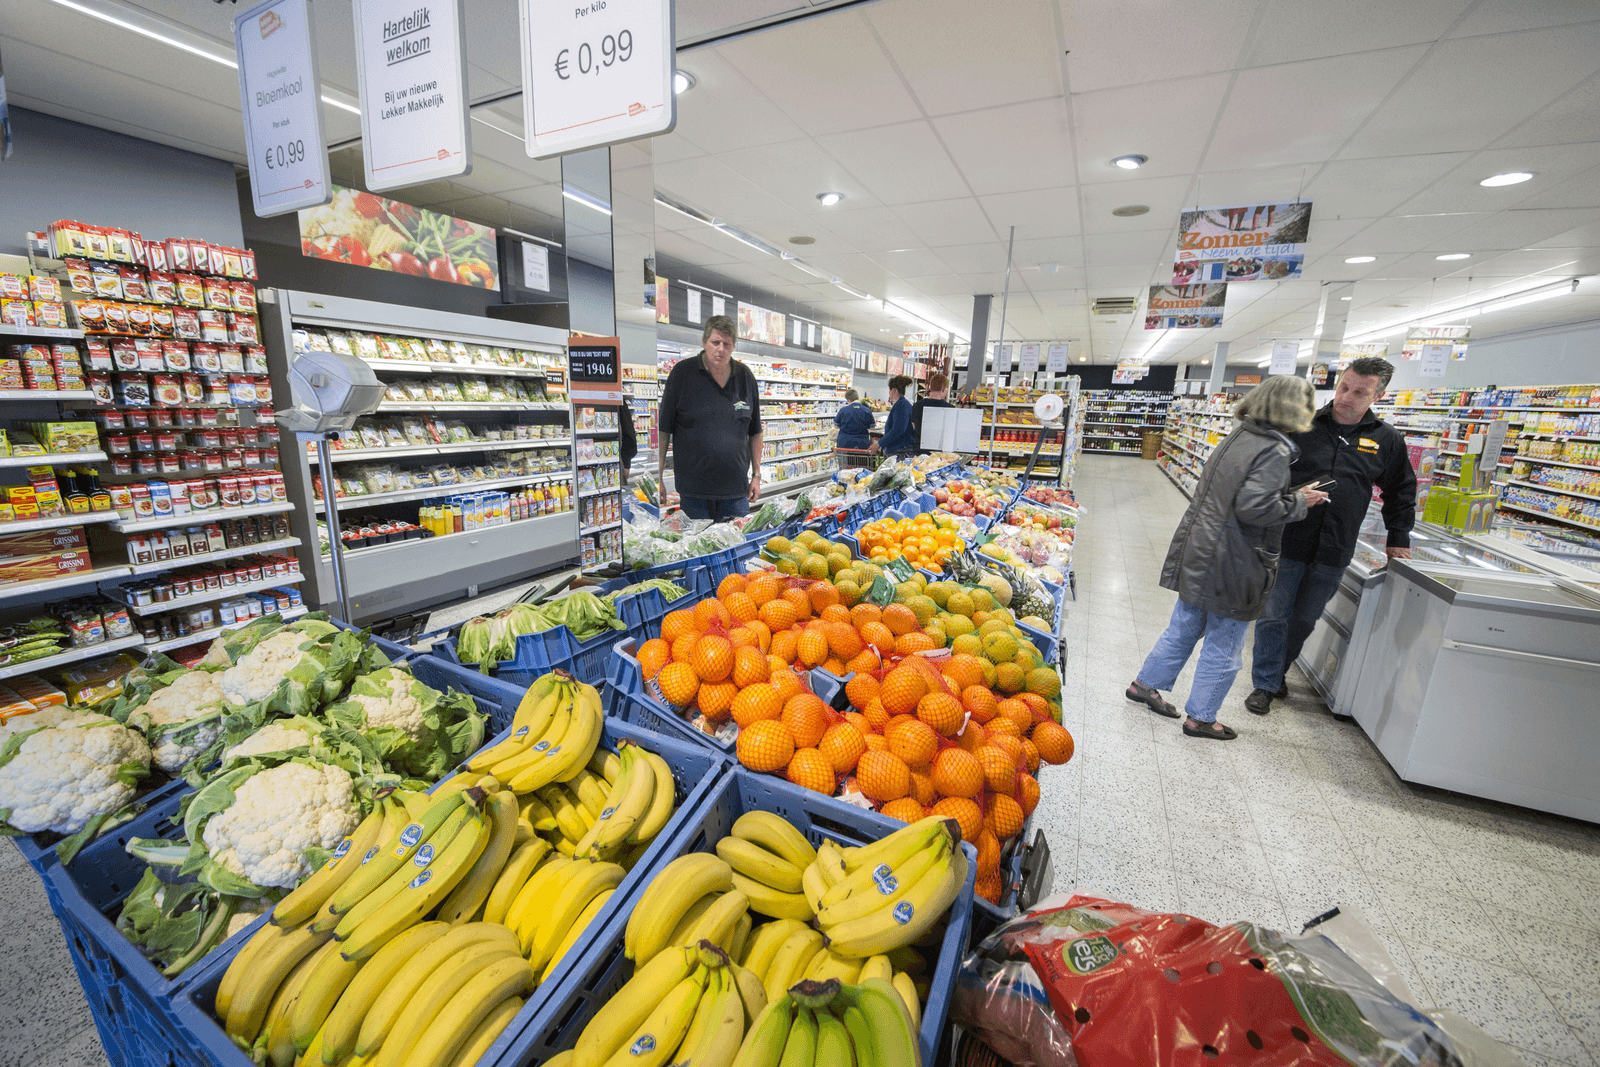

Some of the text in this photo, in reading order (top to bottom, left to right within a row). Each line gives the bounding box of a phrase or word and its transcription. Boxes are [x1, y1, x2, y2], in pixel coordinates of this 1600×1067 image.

[575, 1, 607, 19] Per kilo
[383, 7, 430, 39] Hartelijk
[386, 36, 430, 62] welkom
[554, 29, 633, 80] € 0,99
[256, 76, 303, 107] Bloemkool
[384, 80, 438, 104] Bij uw nieuwe
[381, 93, 444, 120] Lekker Makkelijk
[265, 139, 305, 170] € 0,99
[1181, 231, 1270, 250] Zomer
[1200, 247, 1241, 259] Neem
[1243, 243, 1261, 256] de
[1264, 241, 1296, 257] tijd!
[1150, 298, 1203, 309] Zomer
[53, 535, 79, 546] GRISSINI
[58, 558, 85, 569] GRISSINI
